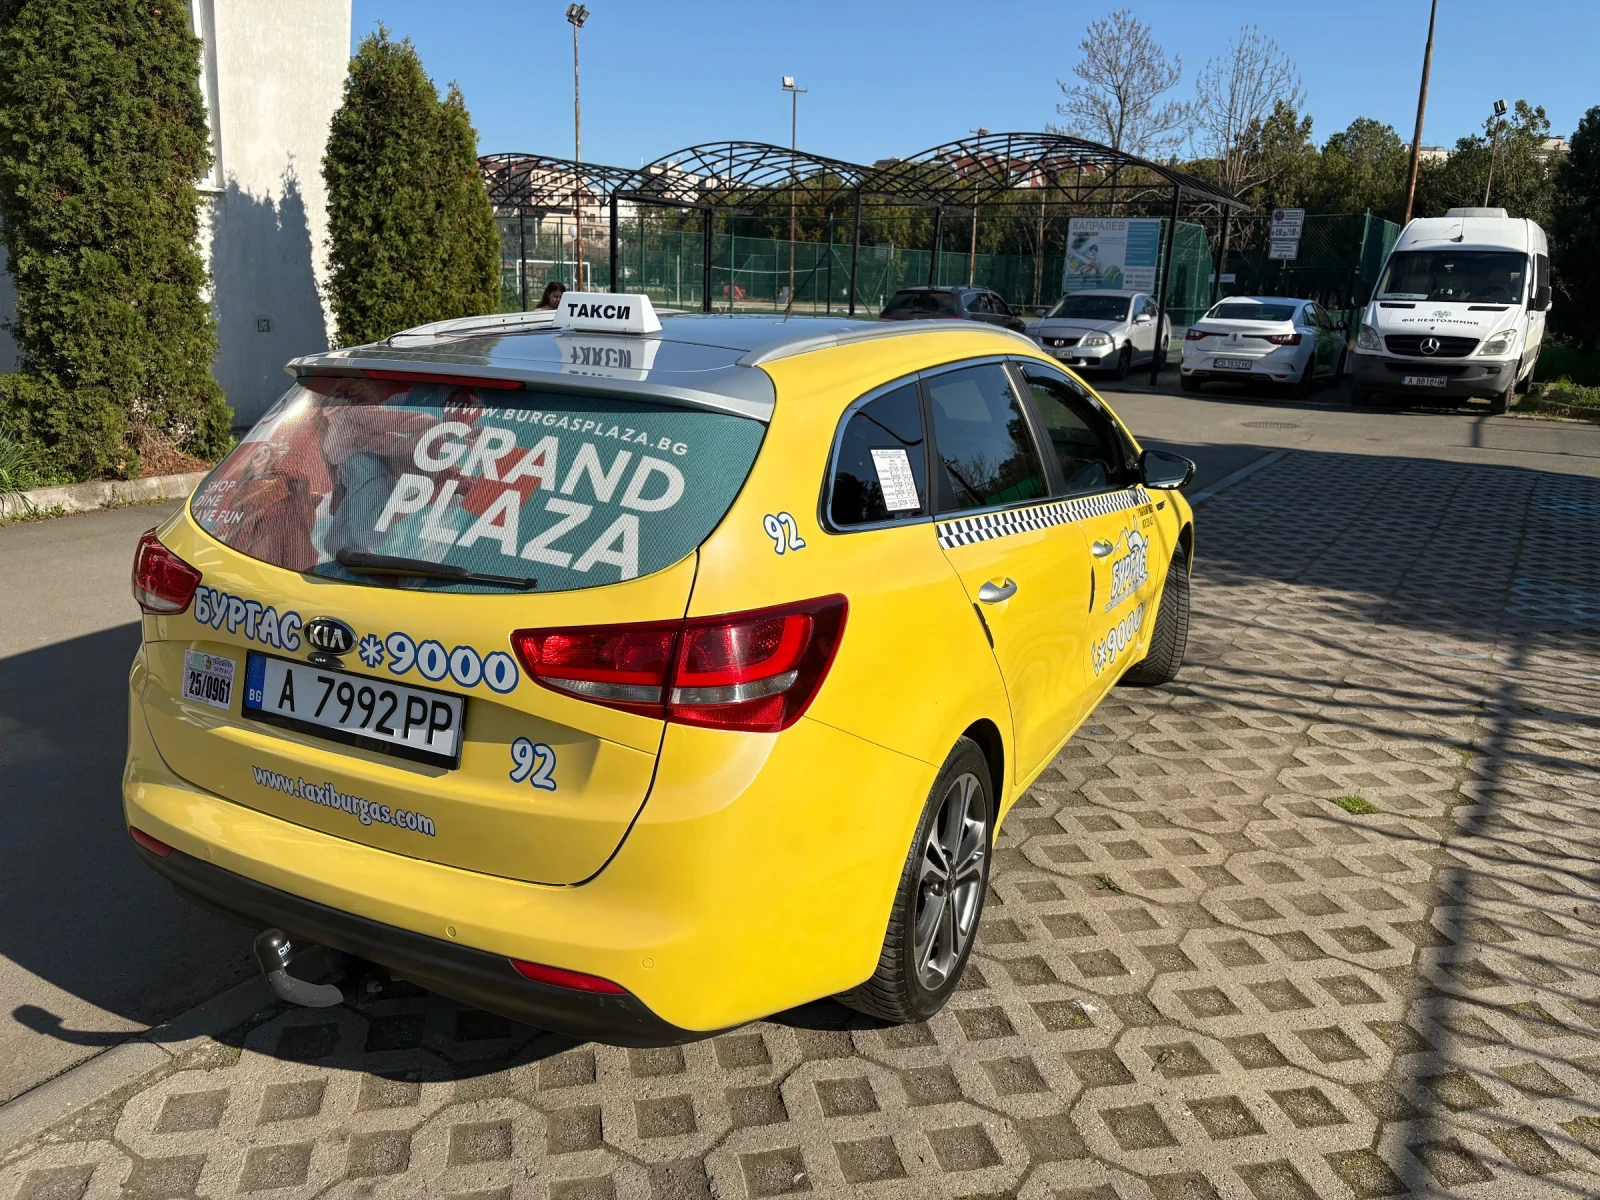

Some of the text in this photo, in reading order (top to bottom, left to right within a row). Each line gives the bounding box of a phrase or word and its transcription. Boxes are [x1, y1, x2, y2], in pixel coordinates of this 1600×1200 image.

[1073, 221, 1125, 231] КАПРАЛЕВ
[567, 303, 631, 320] ТАКСИ
[442, 401, 689, 456] WWW.BURGASPLAZA.BG
[413, 421, 686, 512] GRAND
[195, 494, 223, 507] DINE
[204, 480, 236, 493] SHOP
[217, 510, 245, 525] FUN
[373, 473, 640, 582] PLAZA
[763, 511, 807, 555] 92
[194, 585, 302, 652] БУРГАС
[309, 624, 345, 650] KIA
[189, 671, 231, 704] 25/0961
[249, 688, 262, 703] BG
[277, 669, 296, 712] A
[509, 736, 557, 791] 92
[252, 765, 436, 837] www.taxiburgas.com
